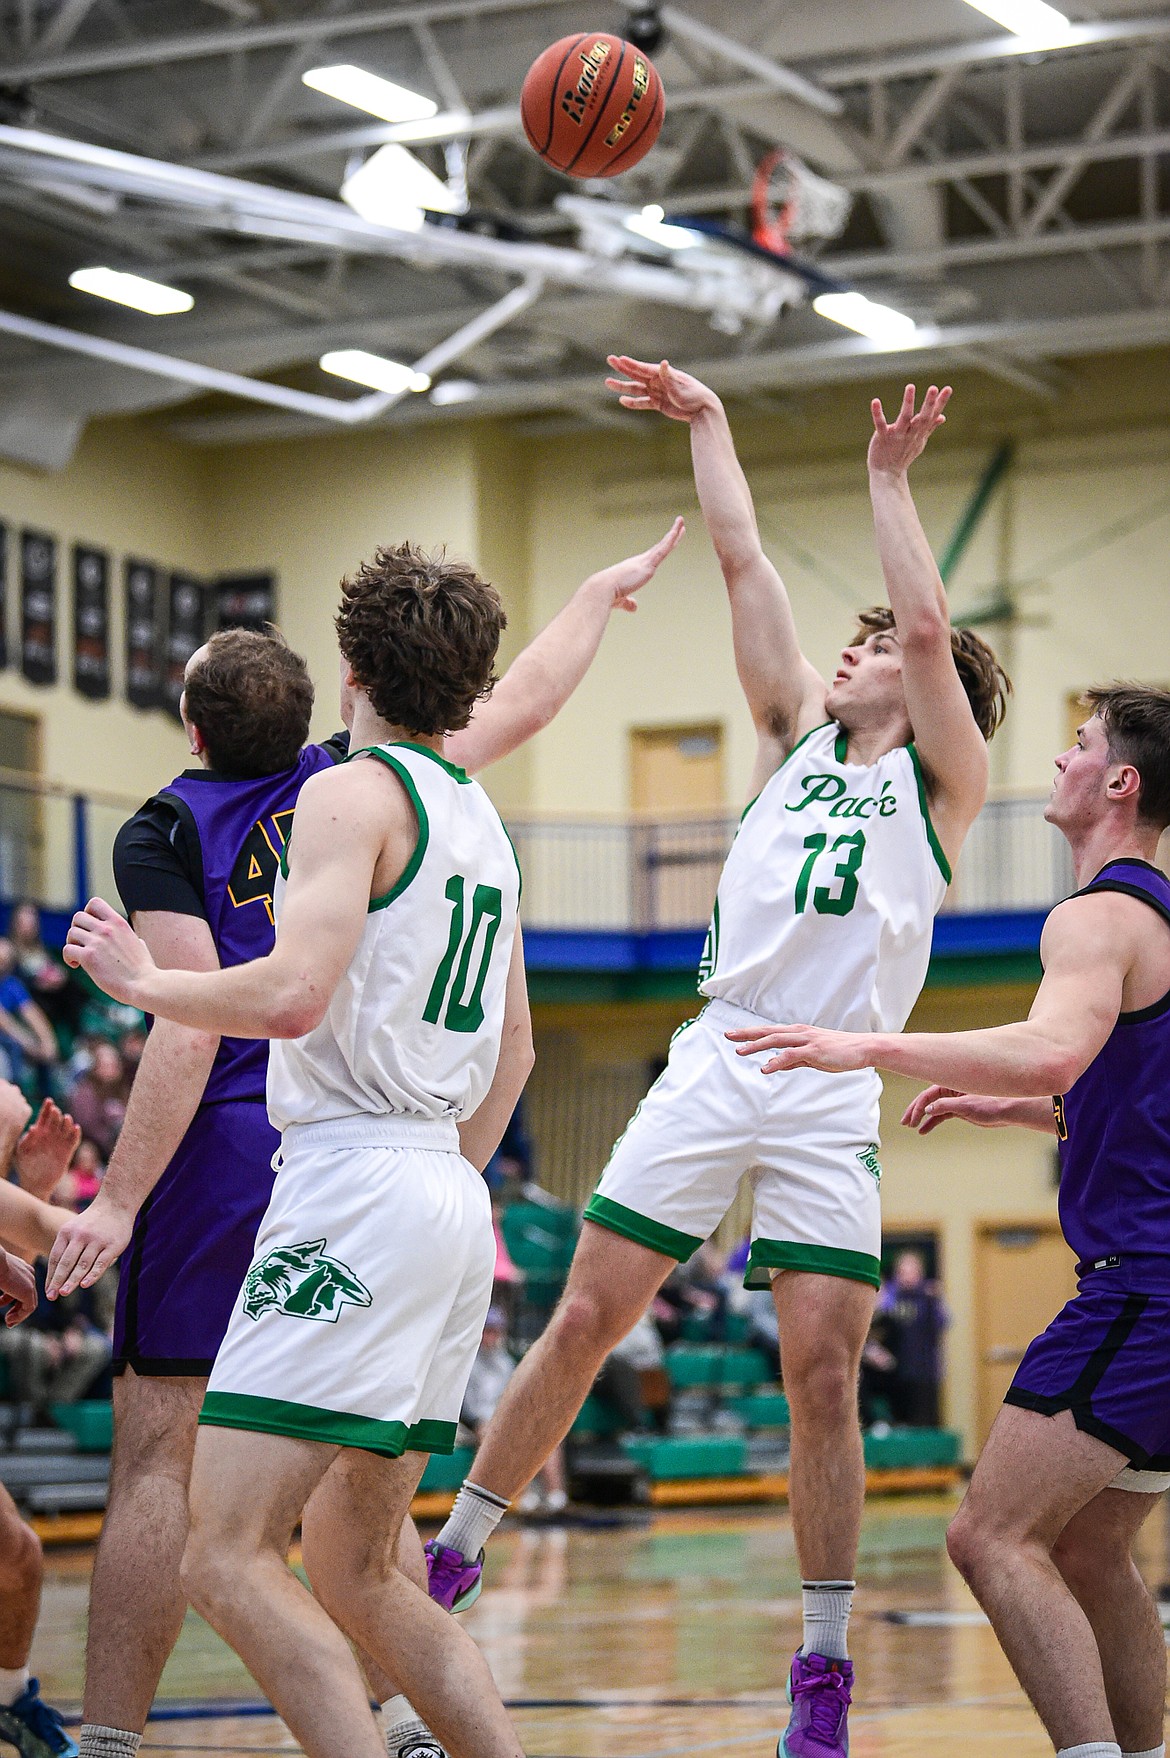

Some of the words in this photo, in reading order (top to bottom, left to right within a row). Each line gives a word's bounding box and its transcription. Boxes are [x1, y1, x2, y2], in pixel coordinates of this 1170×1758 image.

[562, 40, 612, 126] Baden
[785, 773, 897, 819] Pack
[227, 807, 295, 926] 4
[794, 829, 867, 917] 13
[421, 874, 502, 1033] 10
